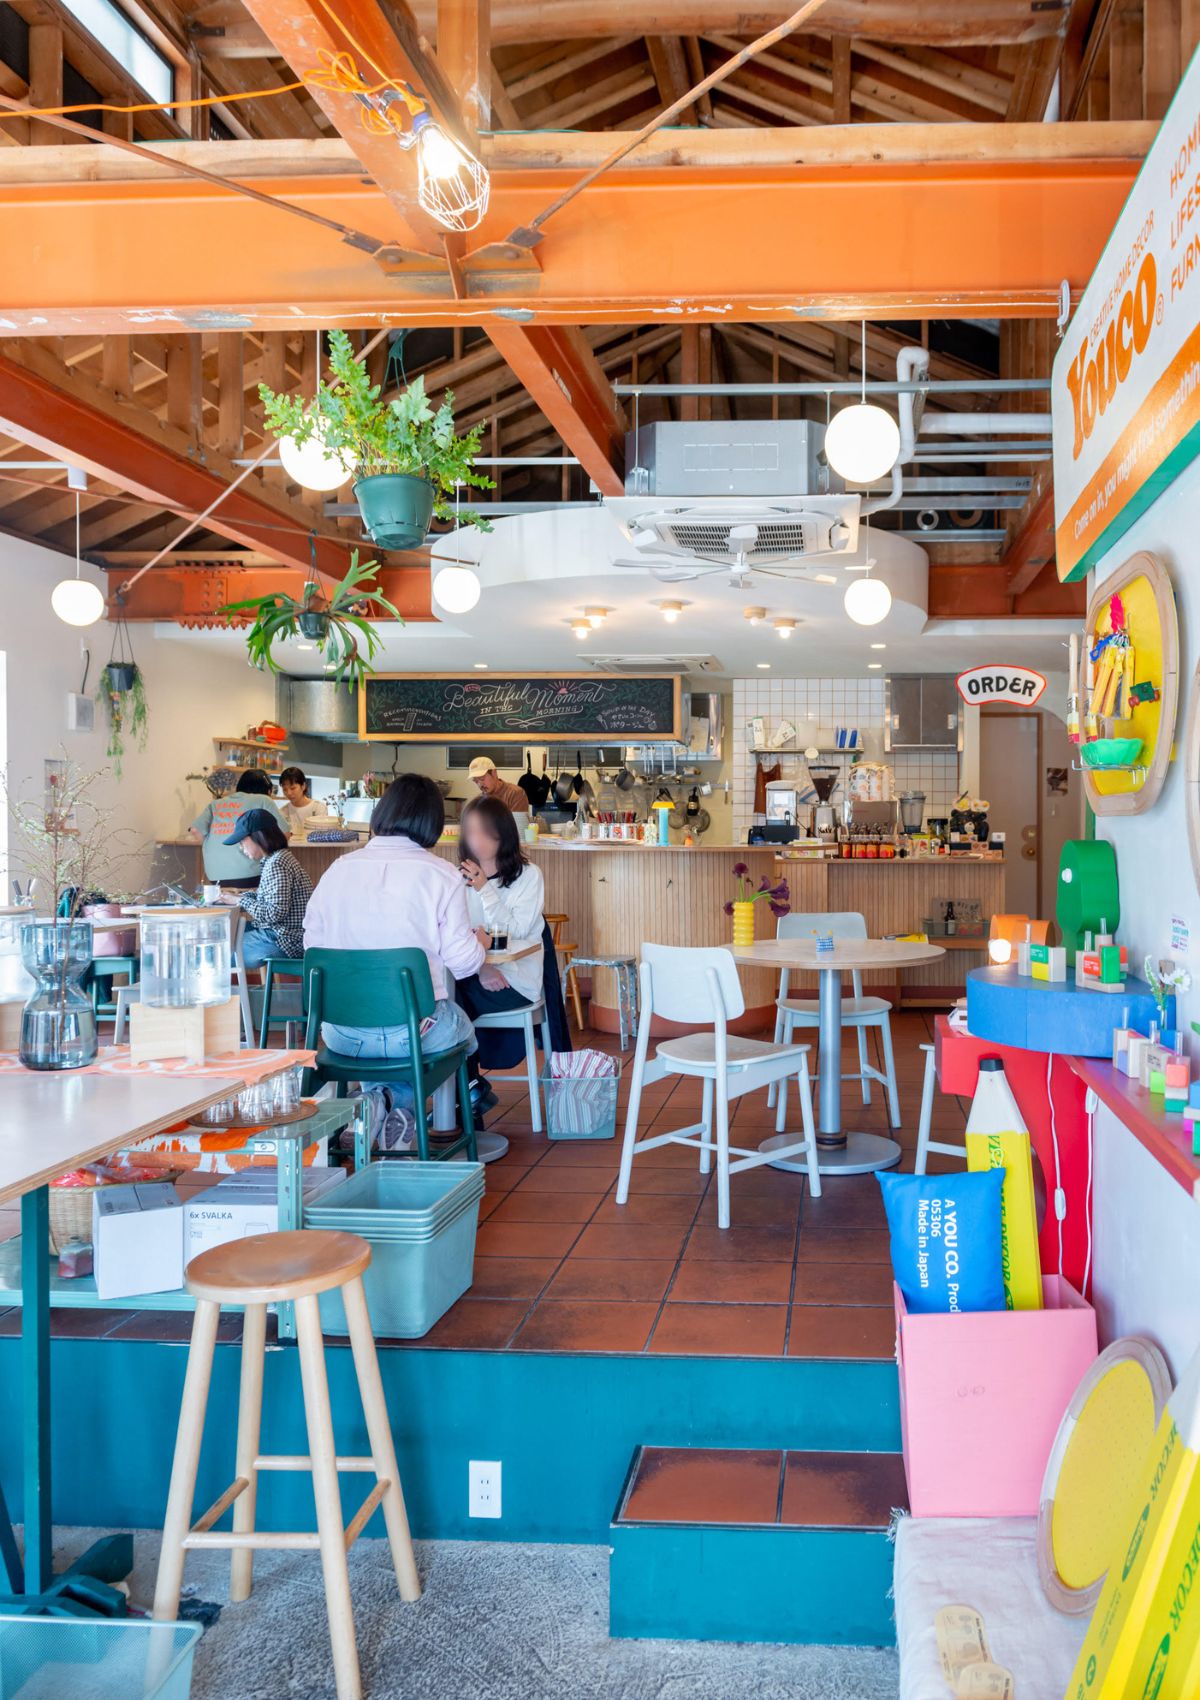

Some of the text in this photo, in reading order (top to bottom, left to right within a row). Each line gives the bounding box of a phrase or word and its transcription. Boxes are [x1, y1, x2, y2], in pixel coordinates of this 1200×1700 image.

[1132, 208, 1154, 266] DECOR
[1074, 508, 1090, 540] Come
[1090, 499, 1097, 522] on
[1105, 470, 1117, 508] you
[1117, 439, 1138, 486] might
[1138, 413, 1155, 455] find
[443, 681, 617, 712] Beautiful Moment
[967, 675, 1036, 697] ORDER
[480, 704, 577, 717] IN THE MORNING
[189, 1211, 233, 1219] 6x SVALKA
[931, 1199, 942, 1237] 05306
[944, 1199, 956, 1208] A
[916, 1199, 930, 1288] Made in Japan
[943, 1211, 958, 1248] YOU
[945, 1251, 960, 1279] CO.
